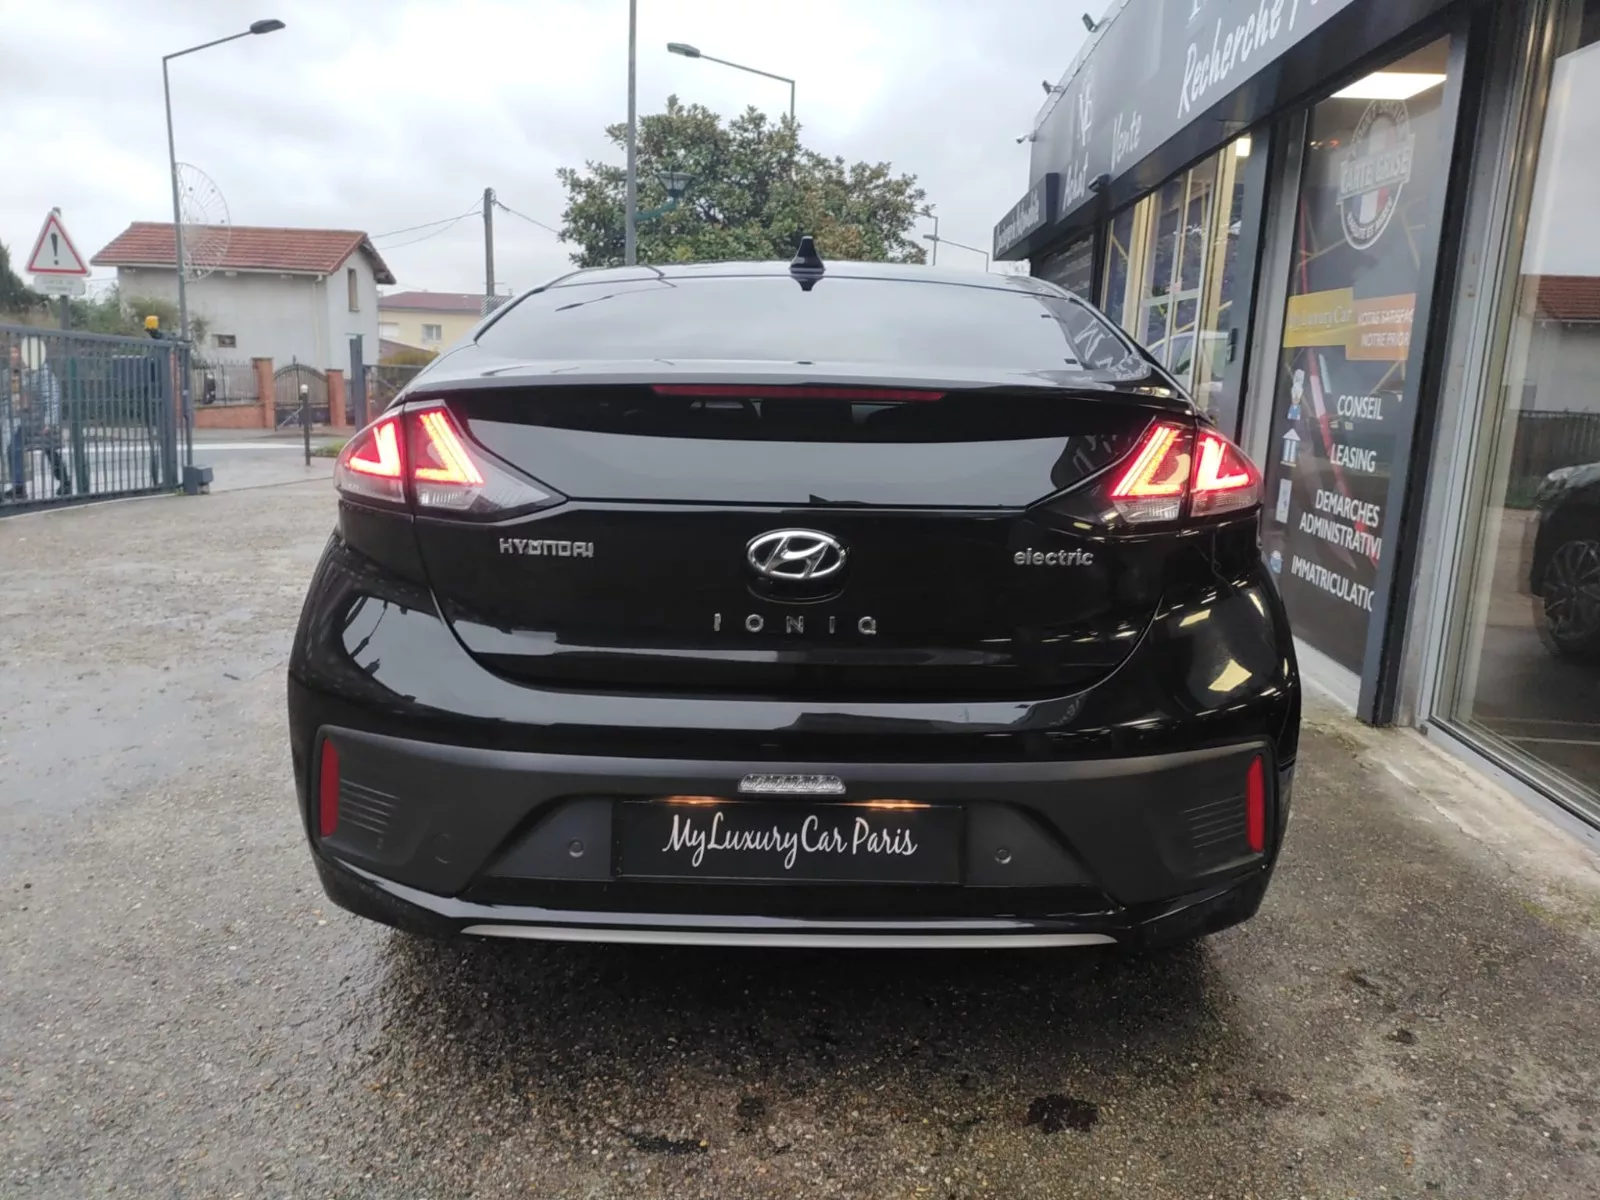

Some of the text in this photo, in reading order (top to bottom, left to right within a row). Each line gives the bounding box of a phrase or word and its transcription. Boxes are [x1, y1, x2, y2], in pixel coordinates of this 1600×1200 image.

[1111, 111, 1143, 173] Vente
[1337, 395, 1383, 420] CONSEIL
[1330, 443, 1377, 473] LEASING
[1315, 489, 1380, 528] DEMARCHES
[1014, 547, 1094, 566] electric
[713, 613, 877, 635] IONIQ
[852, 817, 917, 855] Paris
